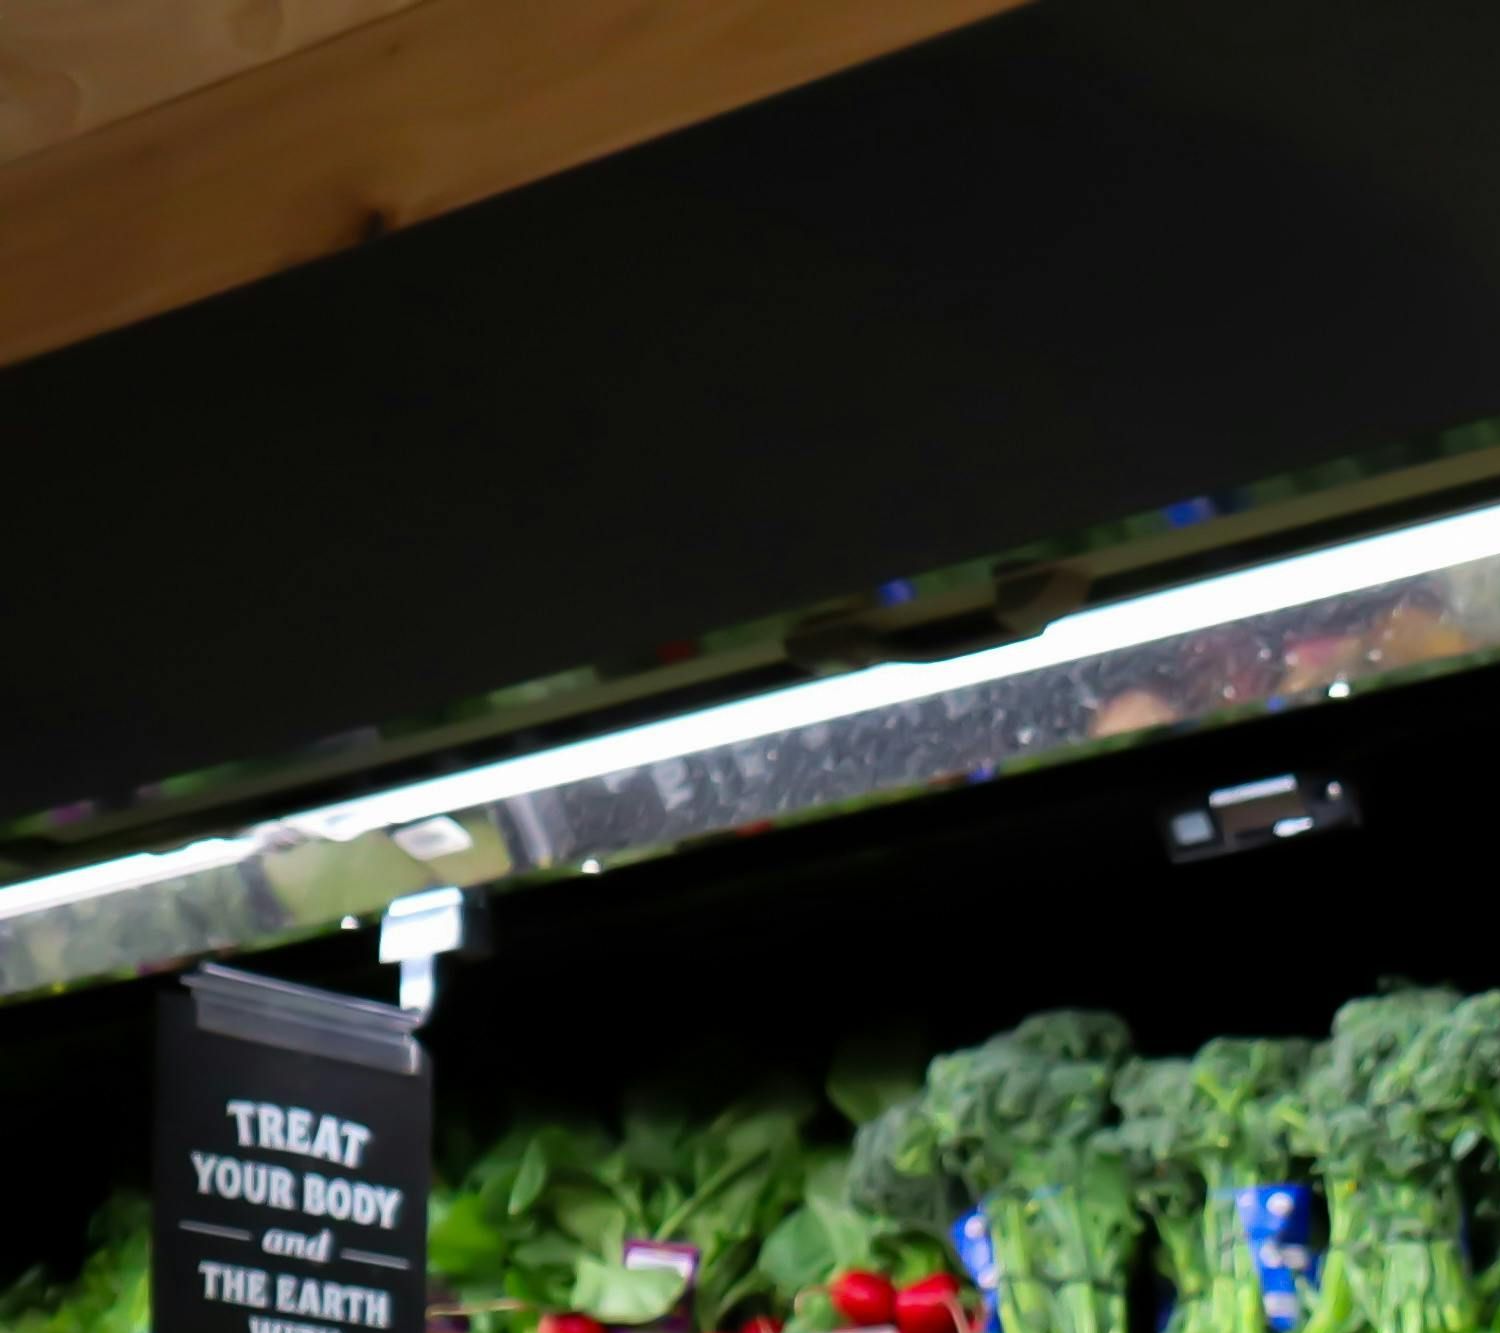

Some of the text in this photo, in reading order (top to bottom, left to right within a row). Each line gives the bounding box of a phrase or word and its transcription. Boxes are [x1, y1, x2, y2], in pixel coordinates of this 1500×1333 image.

[226, 1099, 375, 1169] TREAT
[191, 1150, 403, 1230] YOUR BODY
[262, 1227, 334, 1263] and
[198, 1260, 393, 1330] THE EARTH
